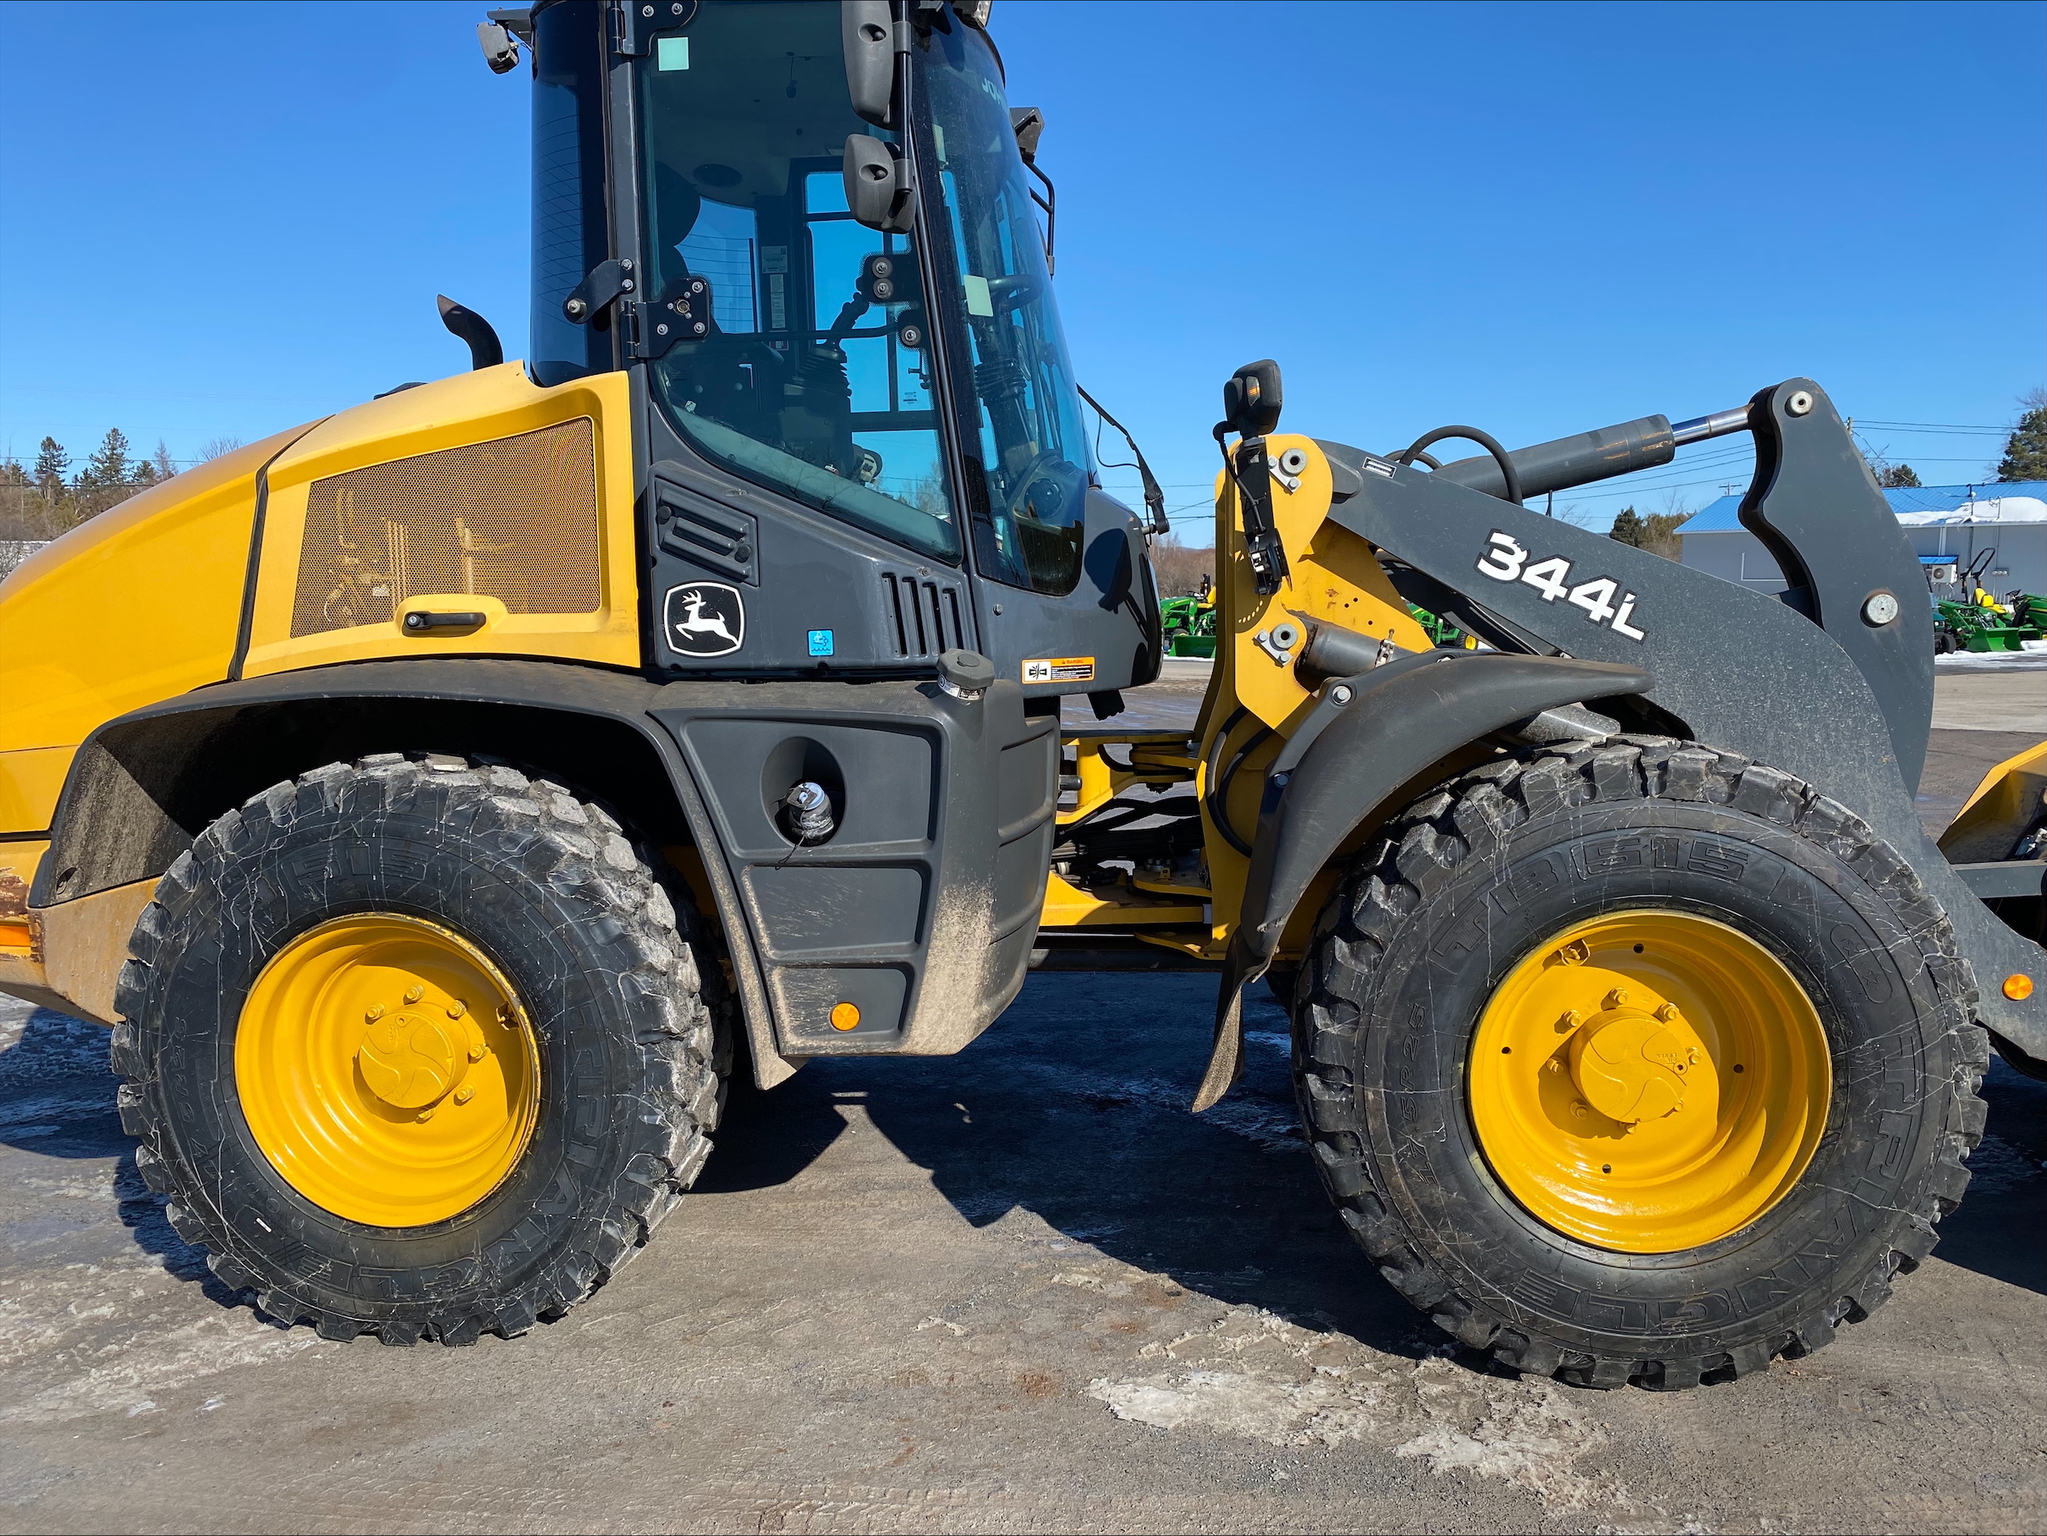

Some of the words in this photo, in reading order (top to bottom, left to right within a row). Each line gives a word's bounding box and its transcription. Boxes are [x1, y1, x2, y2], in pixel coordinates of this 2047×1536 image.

[1476, 530, 1647, 642] 344L
[297, 1002, 606, 1297] TRIANGLE
[1509, 1034, 1917, 1332] TRIANGLE
